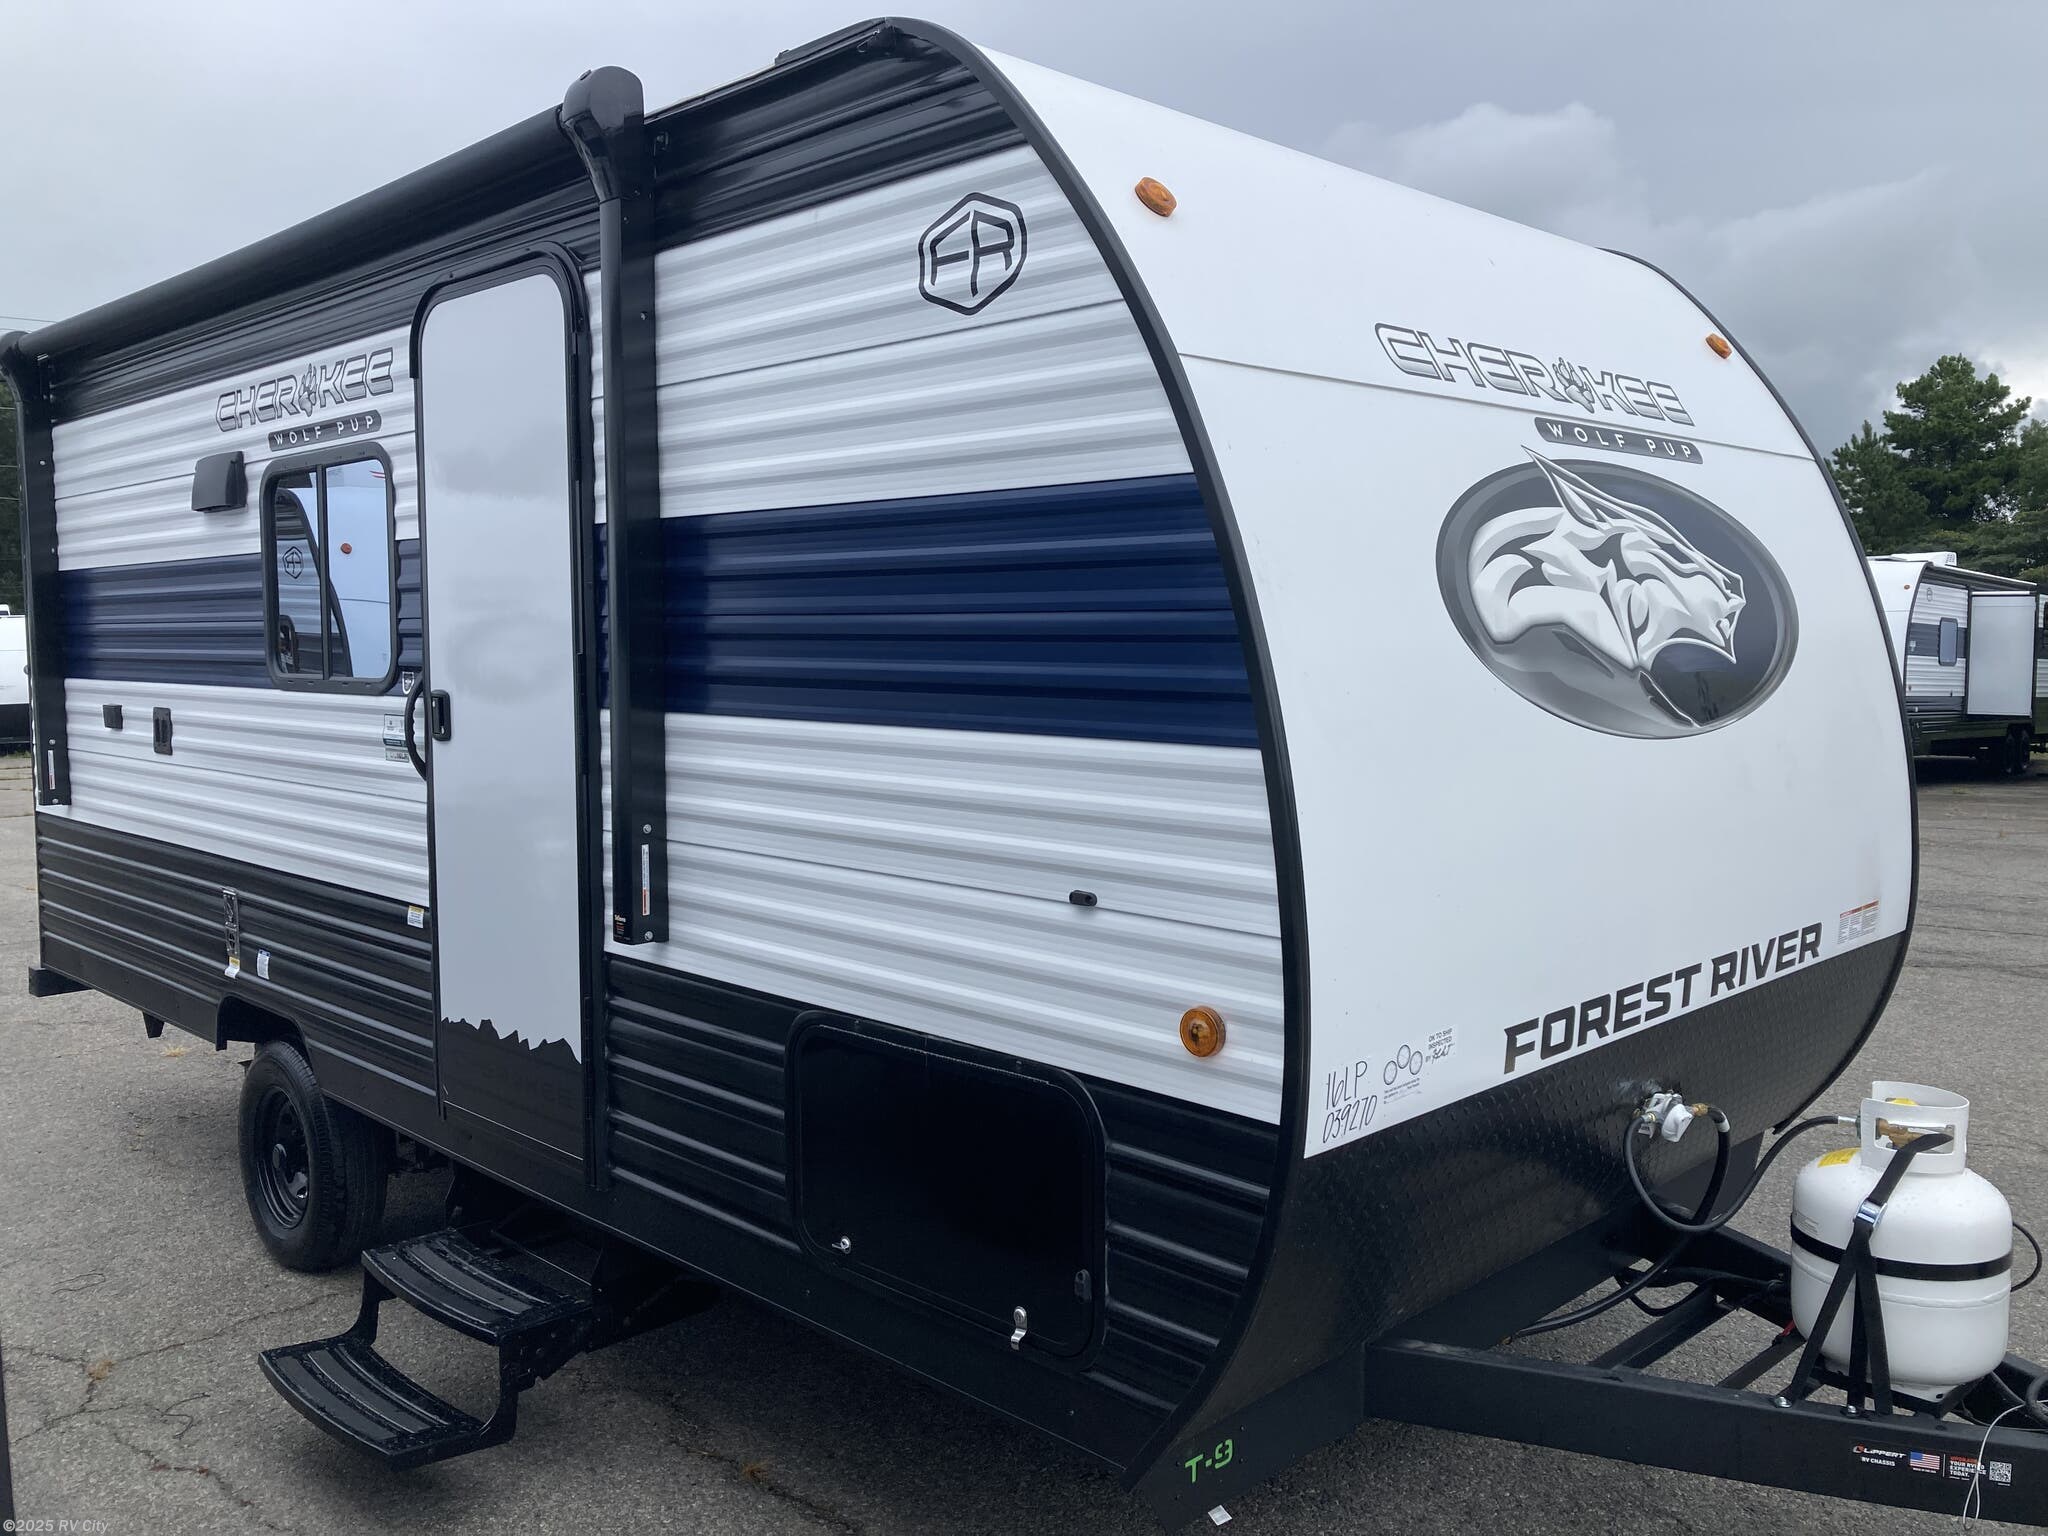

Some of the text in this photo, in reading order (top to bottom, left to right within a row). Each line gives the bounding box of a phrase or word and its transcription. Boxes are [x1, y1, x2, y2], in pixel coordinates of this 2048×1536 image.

[273, 415, 375, 446] WOLF PUP
[1547, 421, 1693, 459] WOLF PUP
[1503, 922, 1823, 1075] FOREST RIVER
[1322, 1095, 1378, 1144] 039270
[1870, 1458, 1896, 1467] CHASSIS
